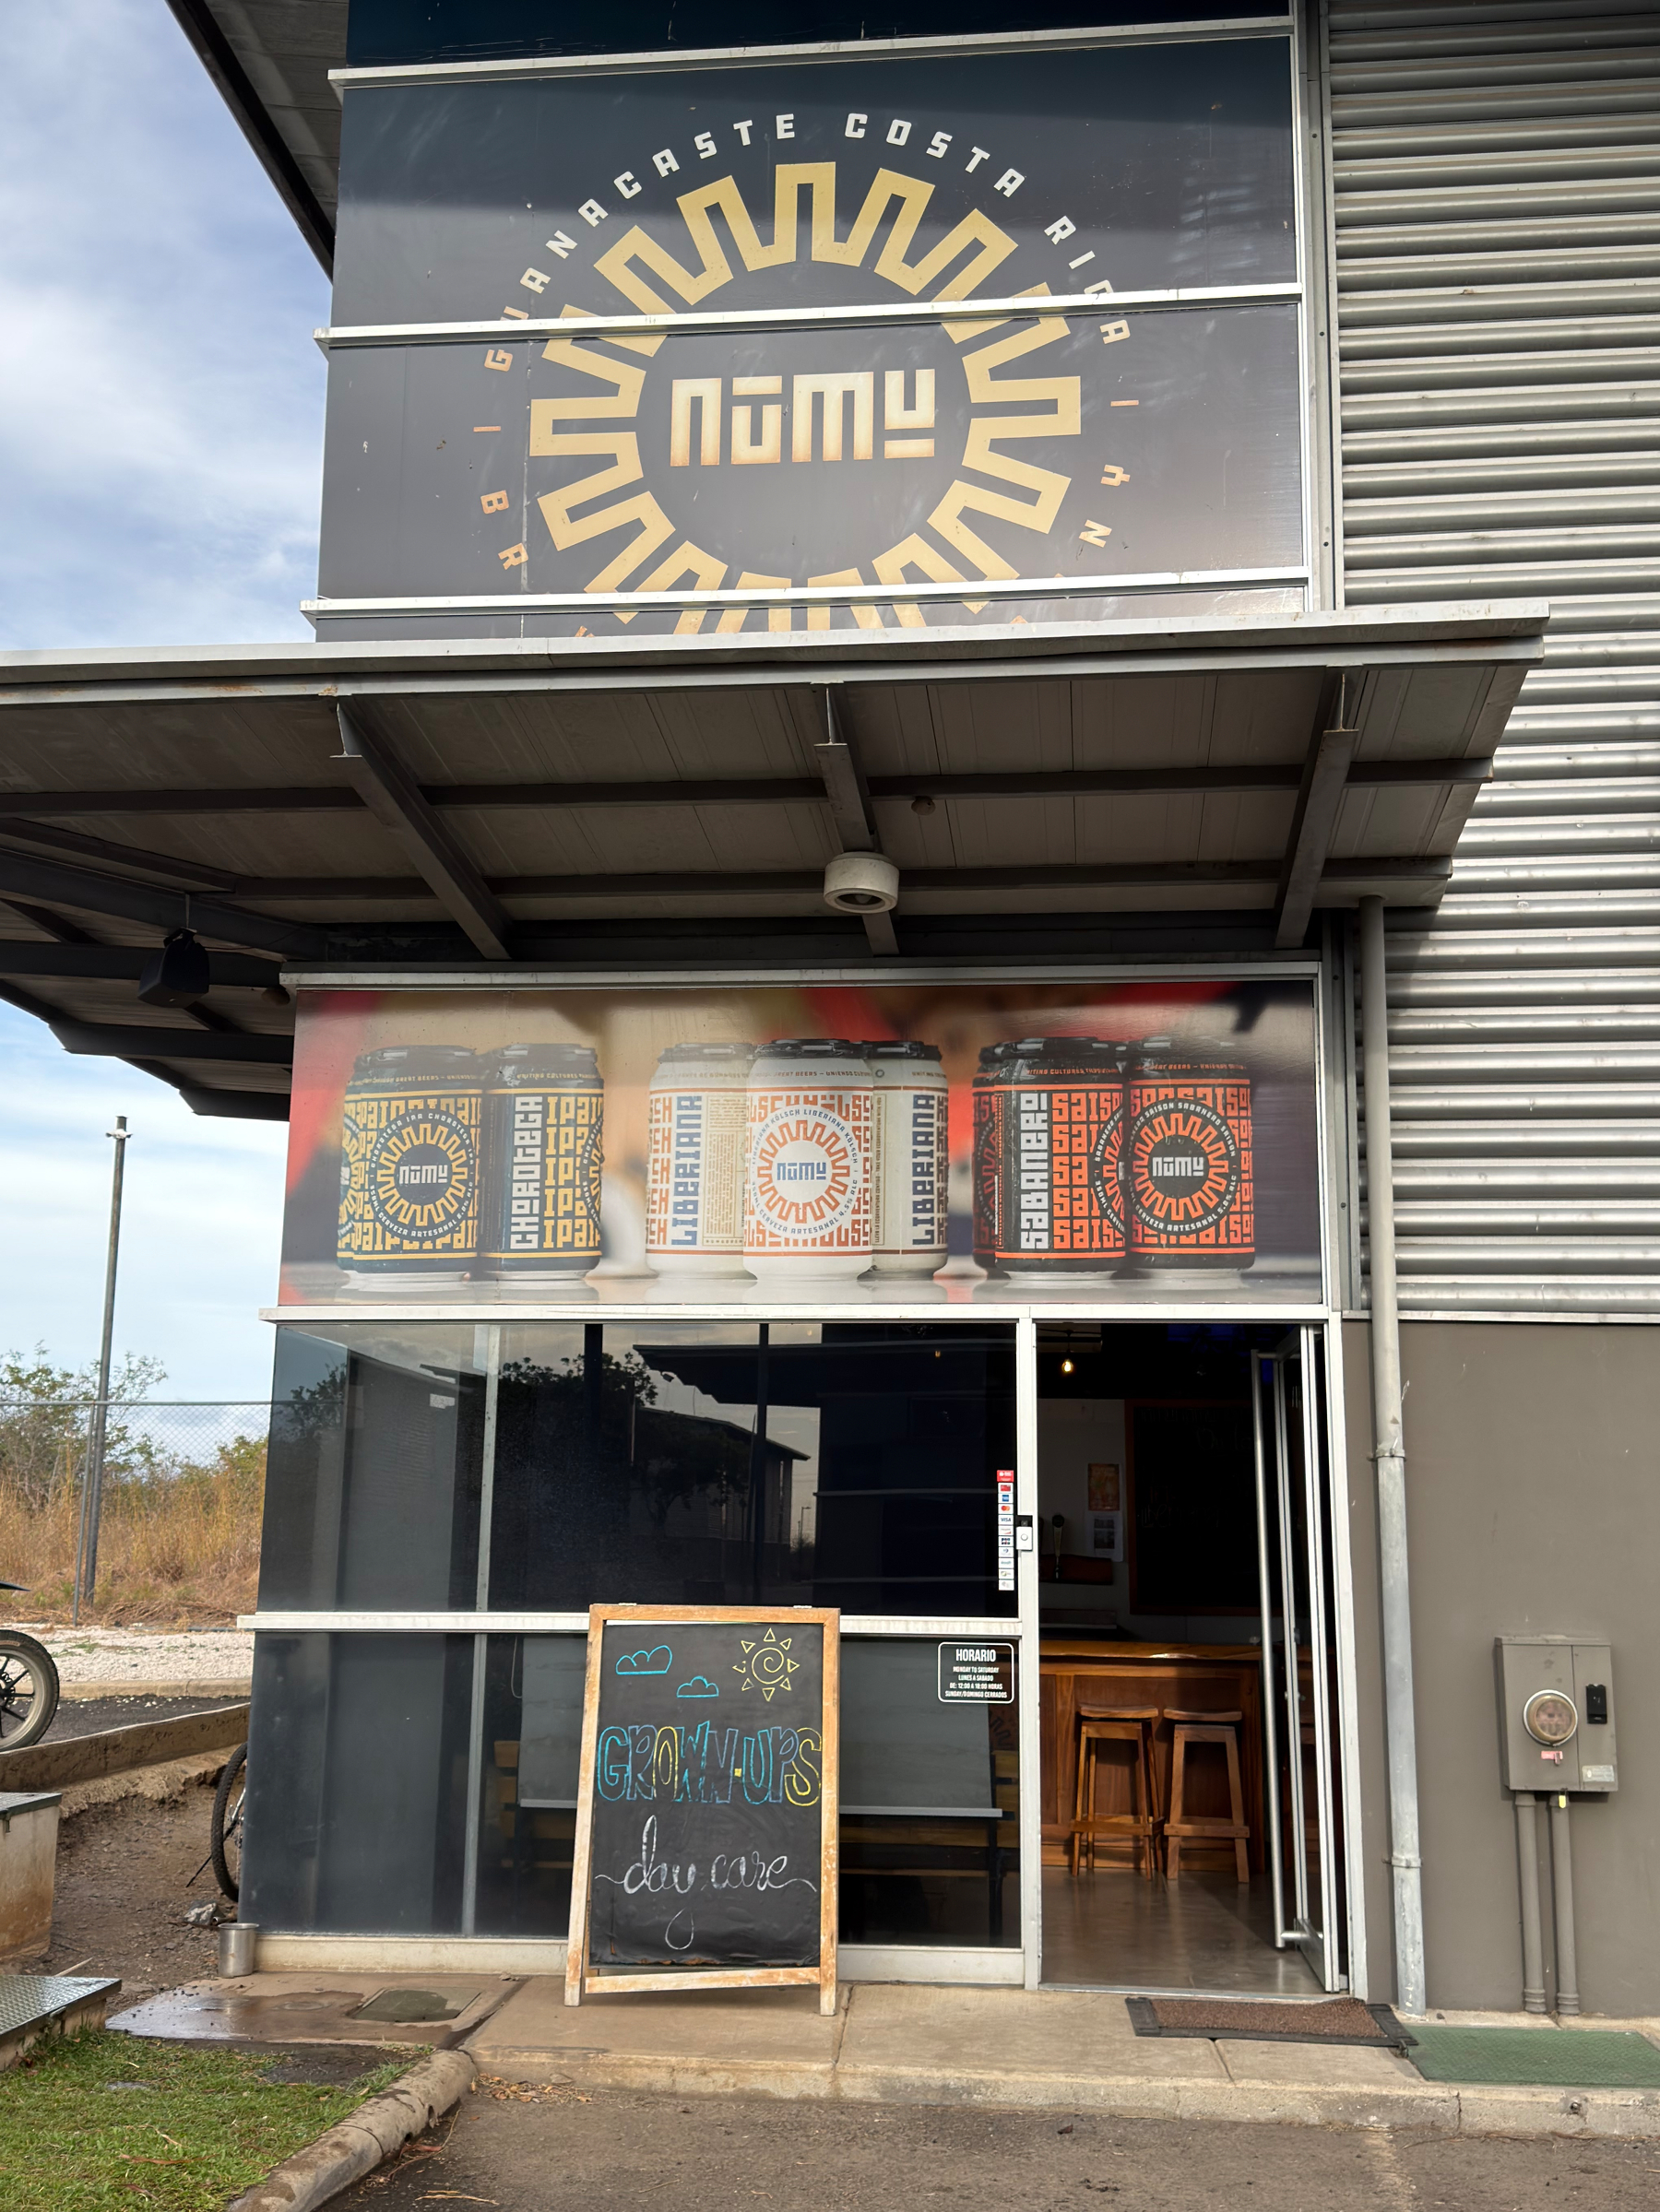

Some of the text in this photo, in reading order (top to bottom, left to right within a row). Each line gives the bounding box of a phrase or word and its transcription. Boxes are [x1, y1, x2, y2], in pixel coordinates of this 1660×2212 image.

[484, 112, 1131, 373] GUANACASTE COSTA RICA
[771, 1108, 800, 1125] KÖLSCH
[803, 1109, 846, 1132] LIBERIANA
[844, 1131, 859, 1164] KÖLSCH
[1144, 1102, 1174, 1119] SAISON
[1178, 1102, 1221, 1126] SABANERO
[1220, 1125, 1236, 1157] SAISON
[510, 1096, 542, 1249] CHOROTEGA
[544, 1156, 581, 1186] IP
[671, 1095, 702, 1246] LIBERIANA
[911, 1094, 935, 1246] LIBERIANA
[1020, 1093, 1049, 1249] SABANERO
[378, 1212, 409, 1236] CERVEZA
[410, 1219, 457, 1237] ARTESANAL
[759, 1209, 788, 1233] CERVEZA
[790, 1217, 839, 1235] ARTESANAL
[838, 1197, 854, 1217] 4.5%
[1135, 1204, 1165, 1230] CERVEZA
[1167, 1213, 1217, 1232] ARTESANAL
[955, 1649, 996, 1662] HORARIO
[616, 1815, 799, 1950] day care
